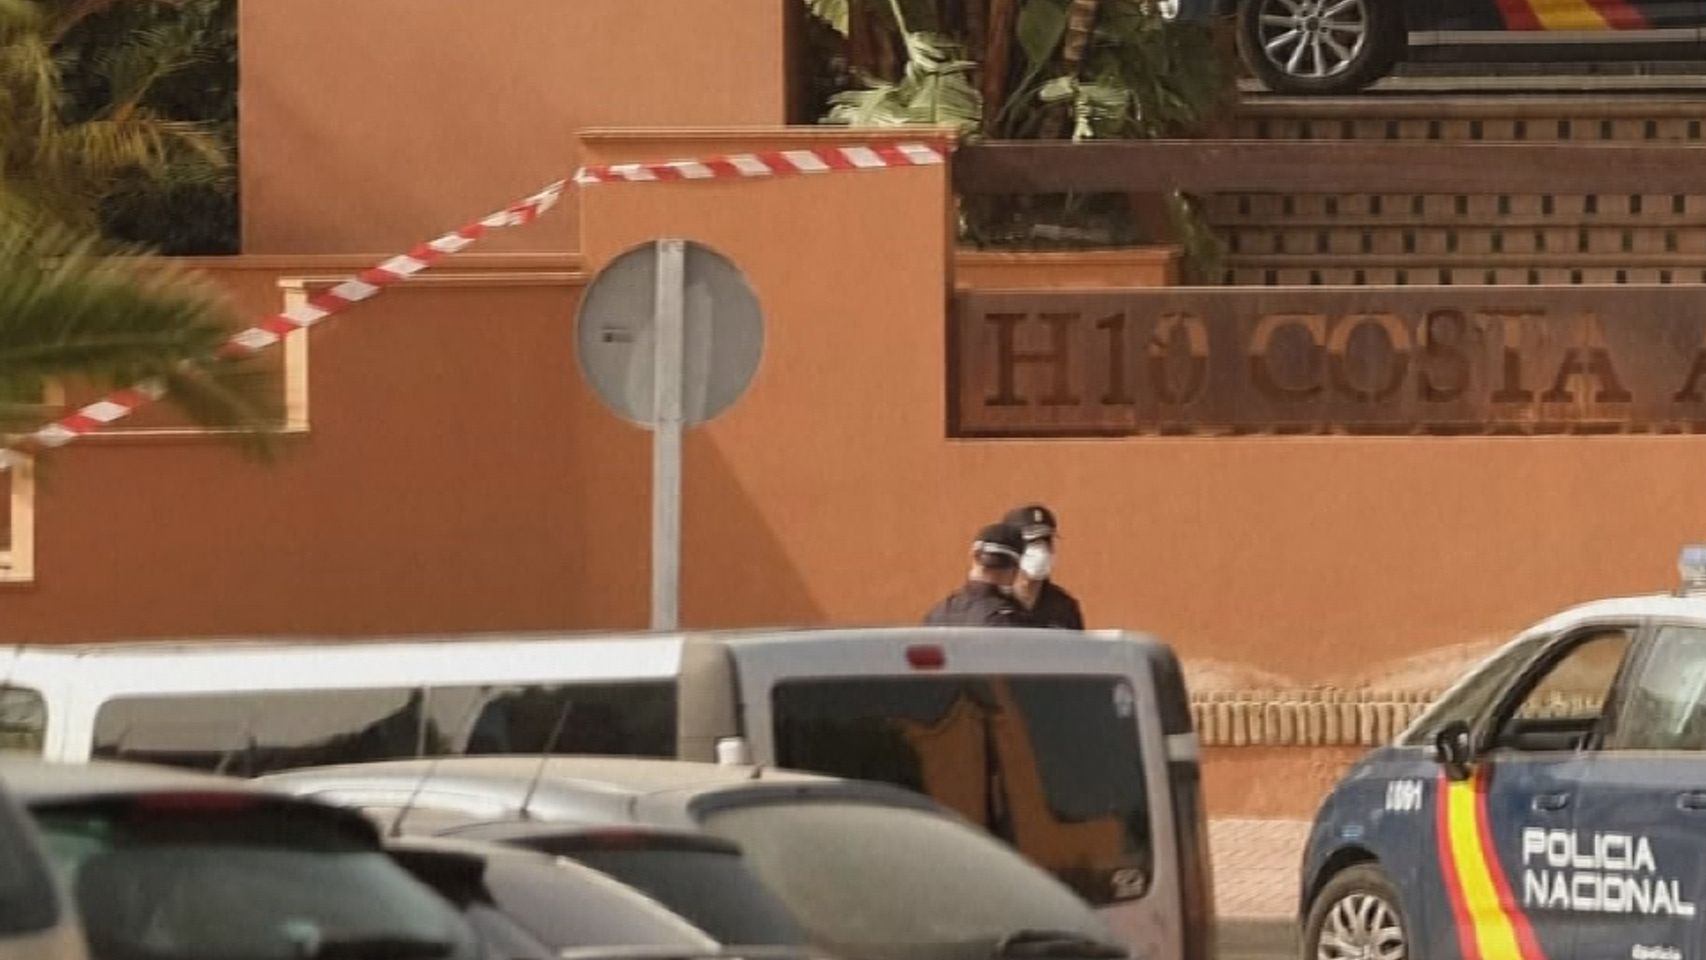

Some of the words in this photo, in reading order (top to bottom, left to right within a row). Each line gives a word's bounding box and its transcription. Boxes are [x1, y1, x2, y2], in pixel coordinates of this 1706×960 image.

[984, 312, 1209, 406] H10
[1247, 307, 1634, 405] COSTA
[1525, 868, 1695, 917] NACIONAL
